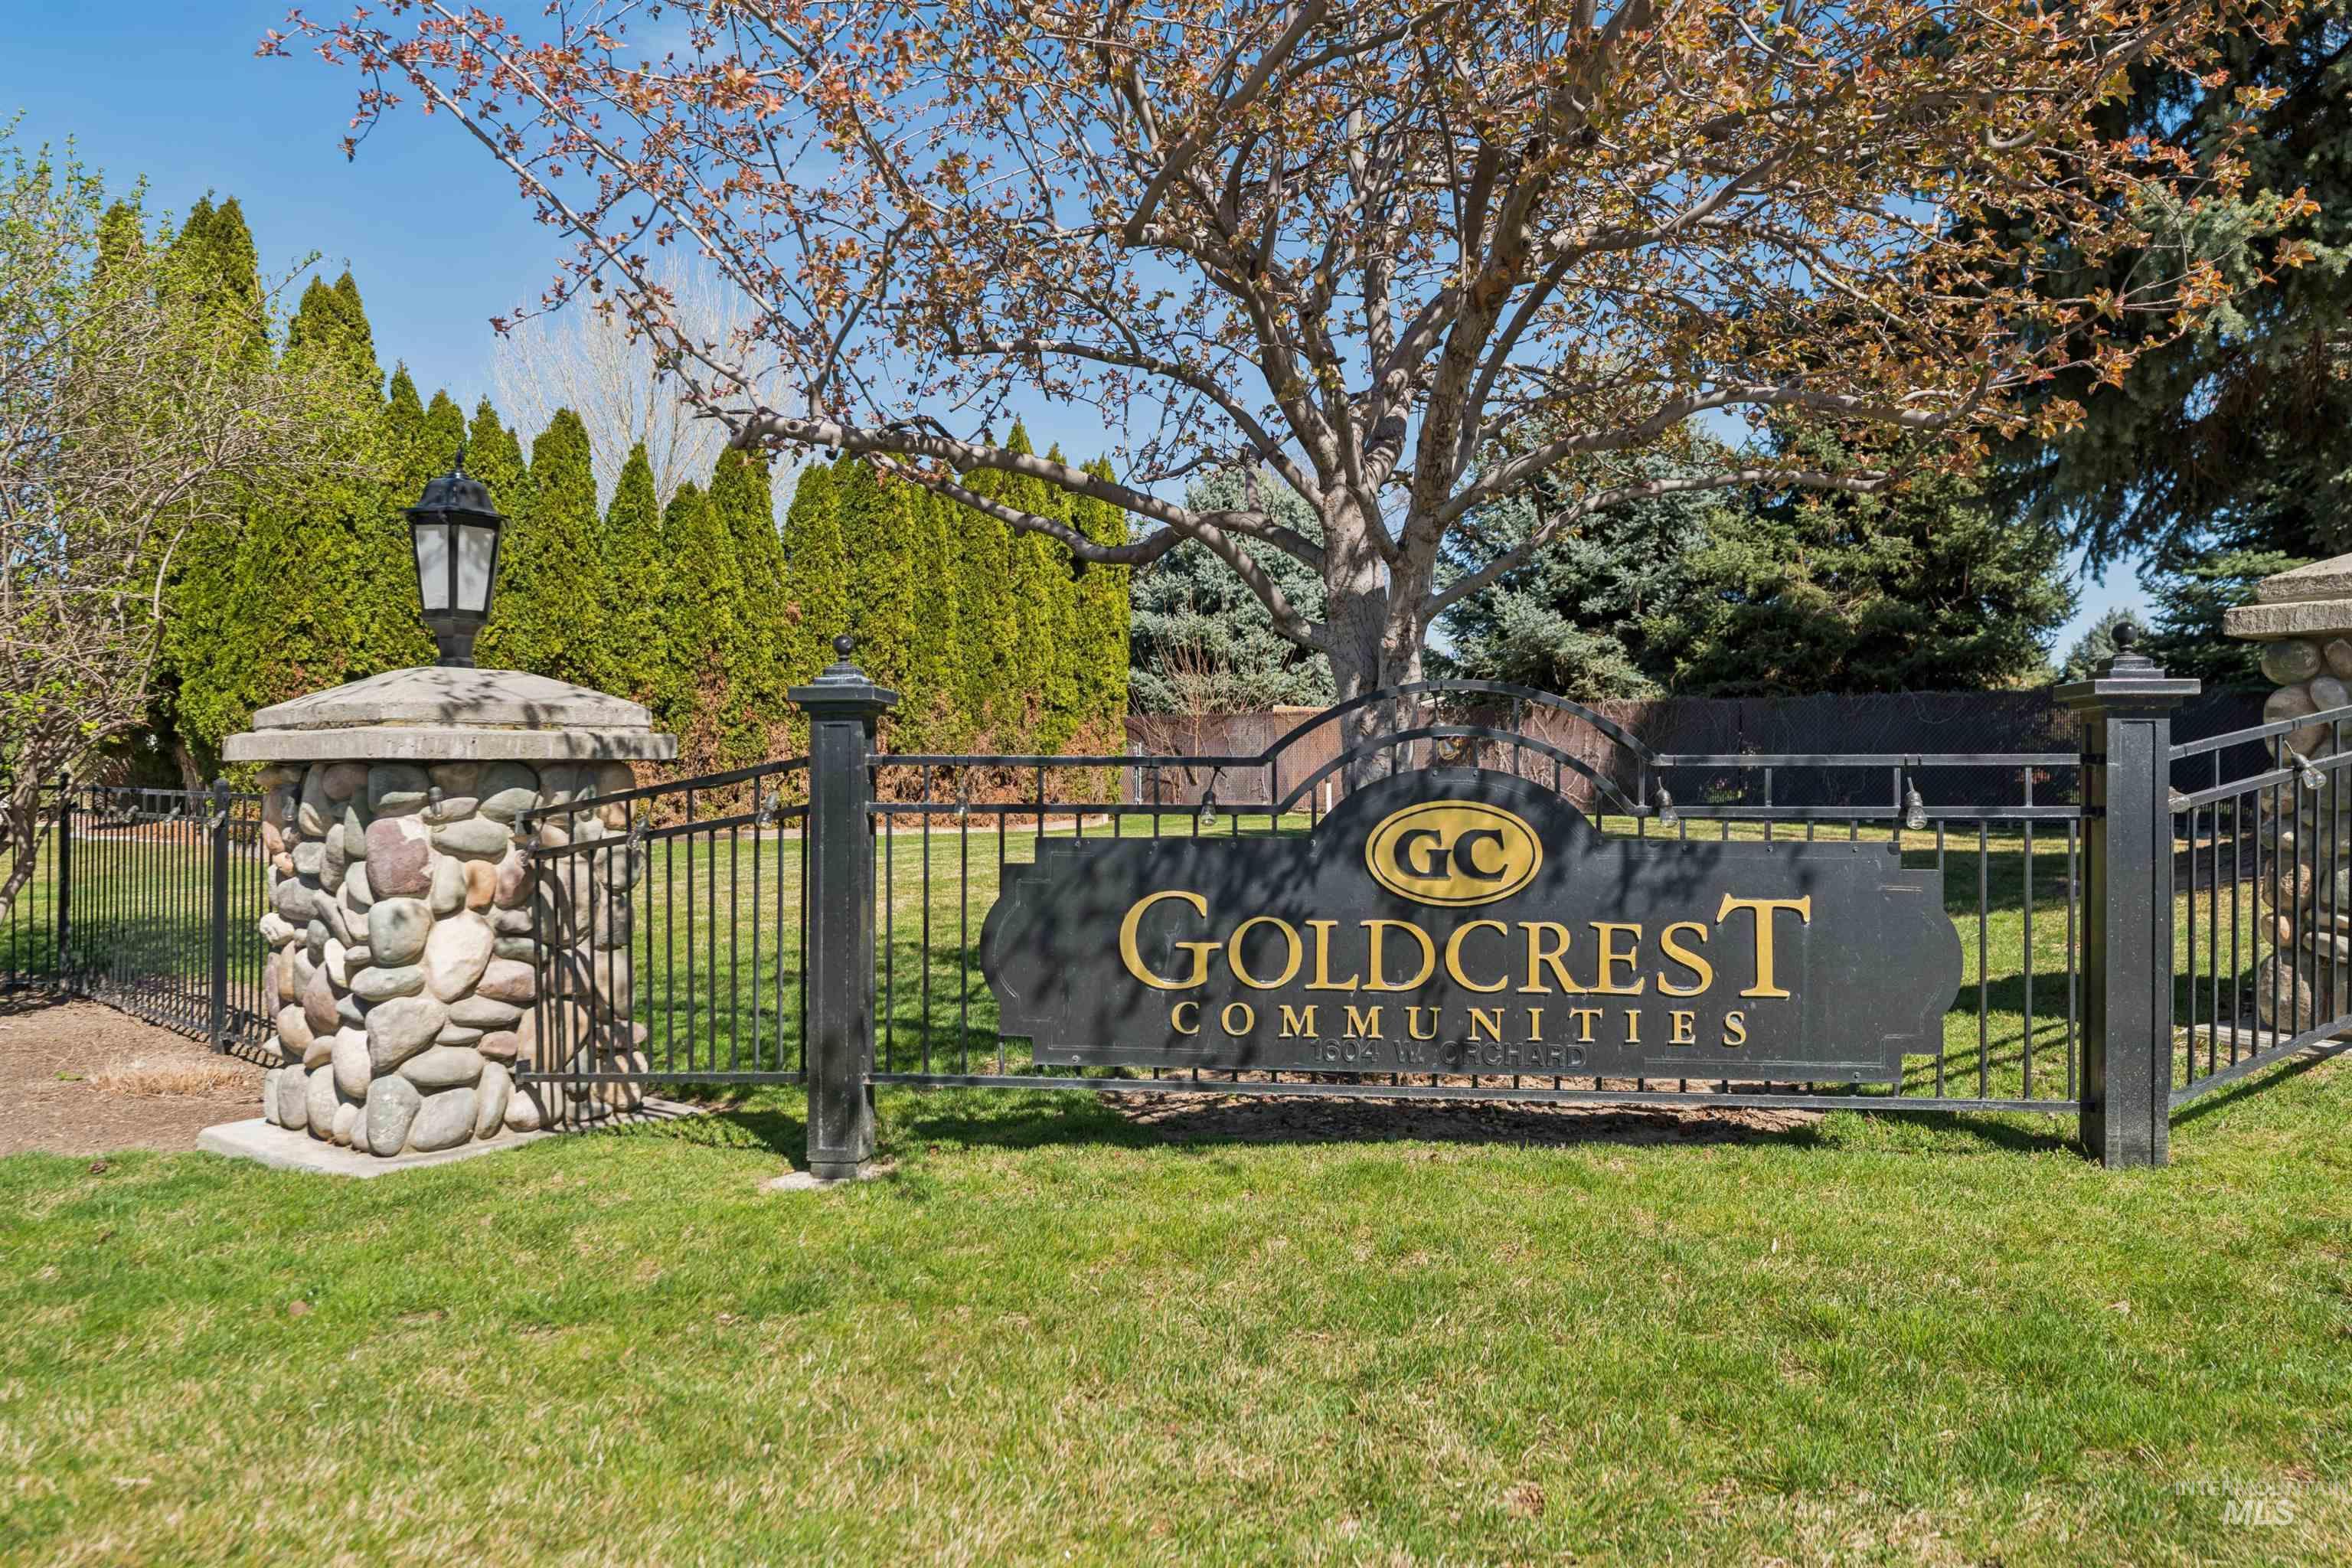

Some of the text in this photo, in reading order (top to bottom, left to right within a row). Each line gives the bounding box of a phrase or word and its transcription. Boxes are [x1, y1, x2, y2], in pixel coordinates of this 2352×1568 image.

[1393, 828, 1508, 882] GC
[1119, 890, 1811, 1000] GOLDCREST
[1170, 1001, 1747, 1047] COMMUNITIES
[1310, 1038, 1587, 1069] 1604 W. ORCHARD
